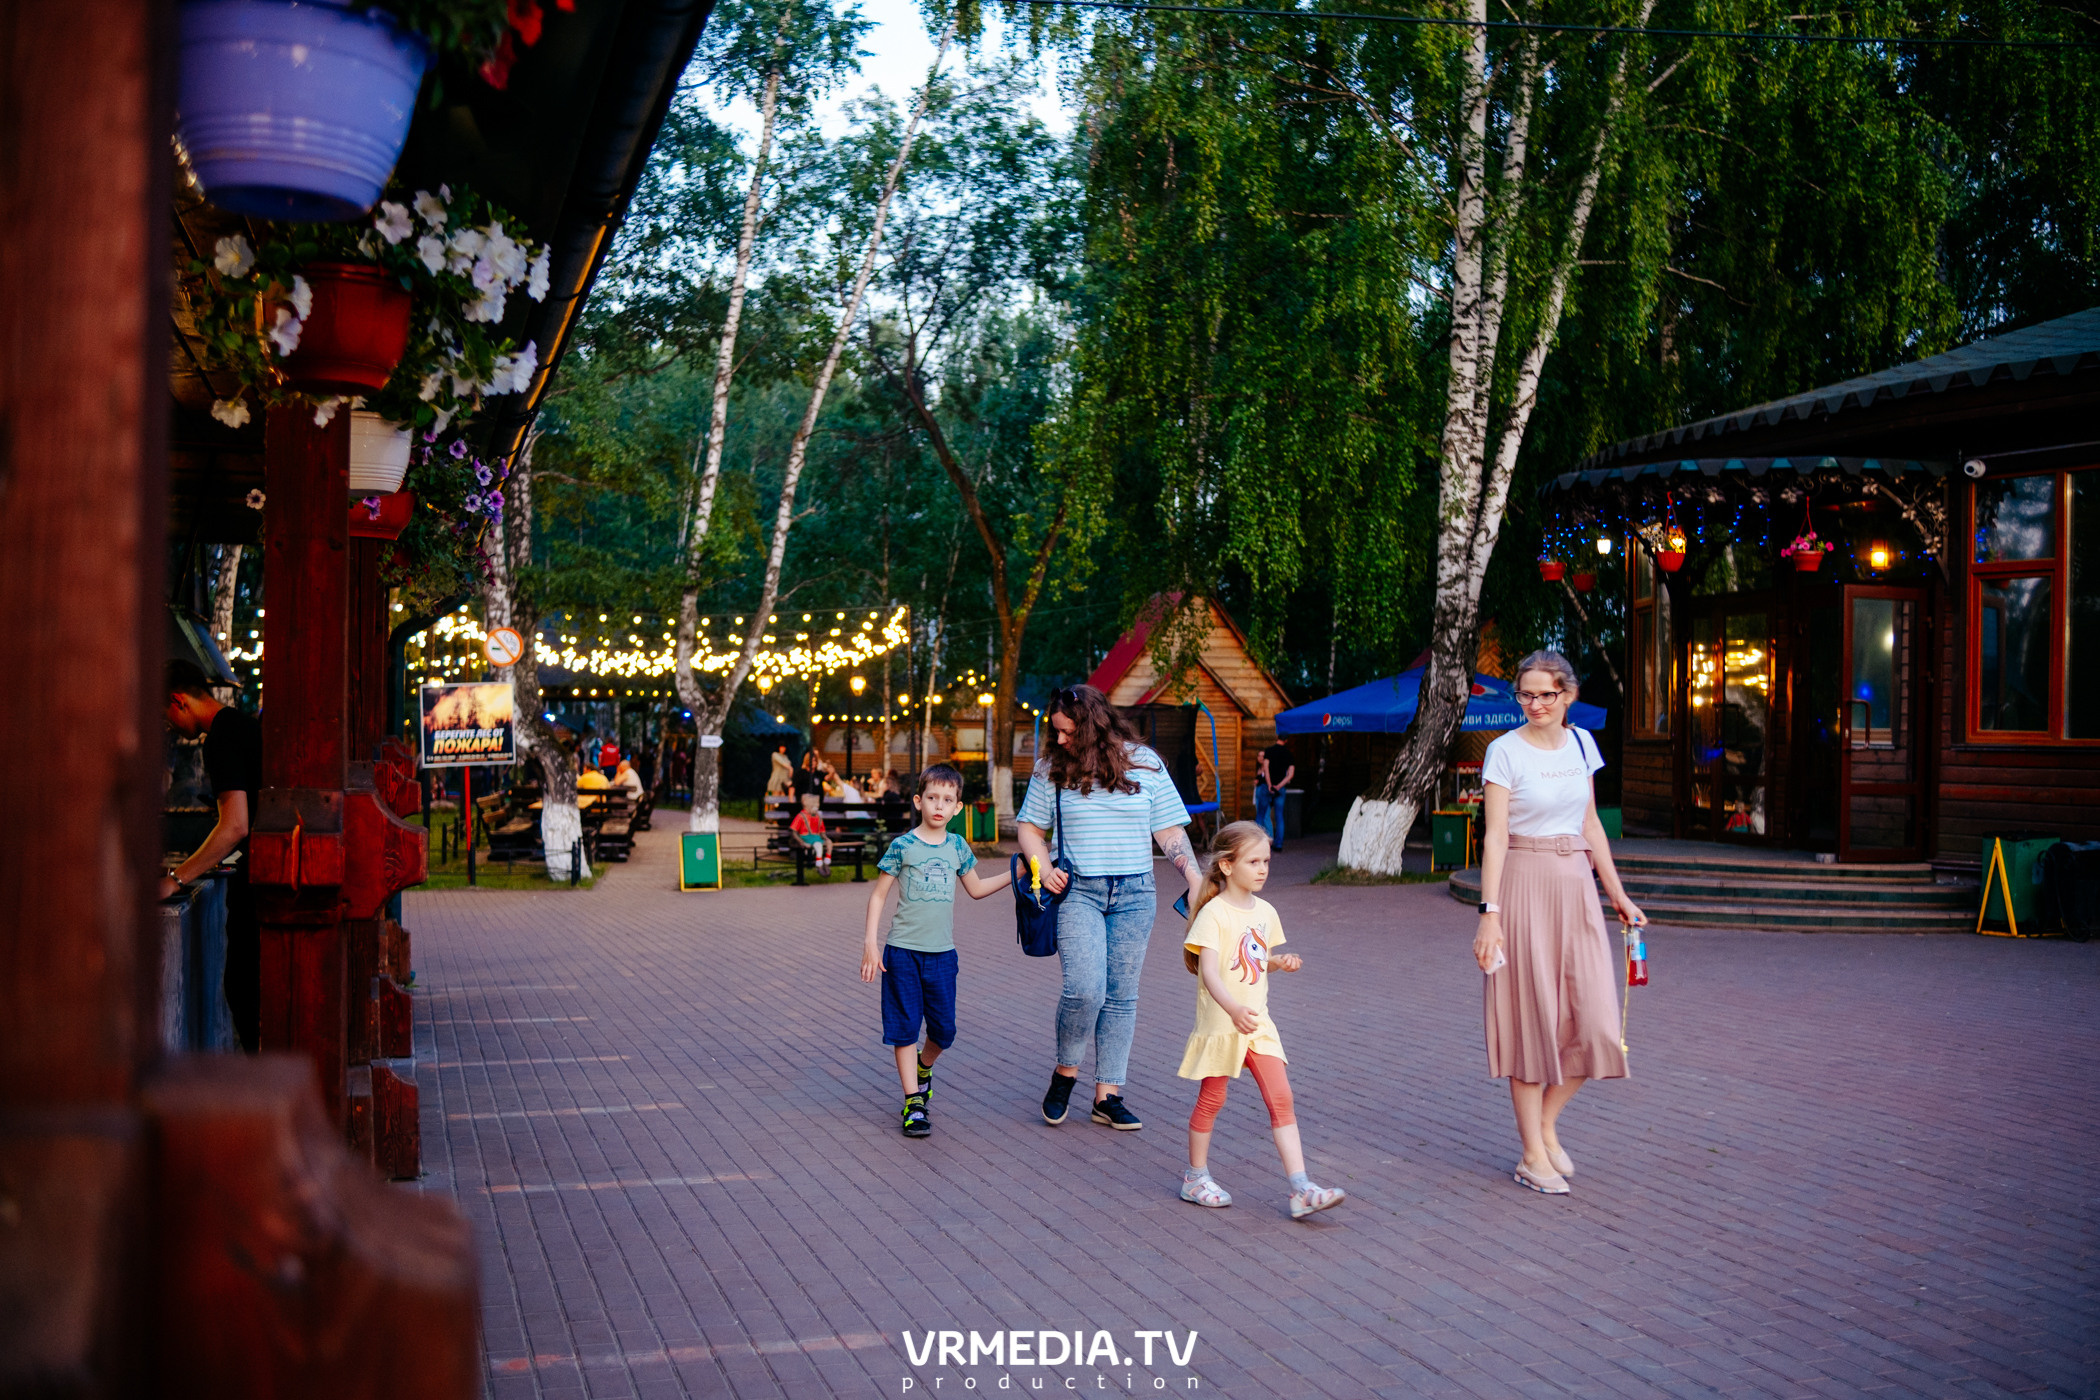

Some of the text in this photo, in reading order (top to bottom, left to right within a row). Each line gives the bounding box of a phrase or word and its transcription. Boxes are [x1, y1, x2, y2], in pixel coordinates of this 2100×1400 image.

[1332, 713, 1353, 728] pepsi
[1484, 712, 1517, 727] ЗДЕСЬ
[434, 727, 504, 740] БЕРЕГИТЕ ЛЕС ОТ
[433, 736, 504, 754] ПОЖАРА!
[1540, 767, 1582, 779] MANGO
